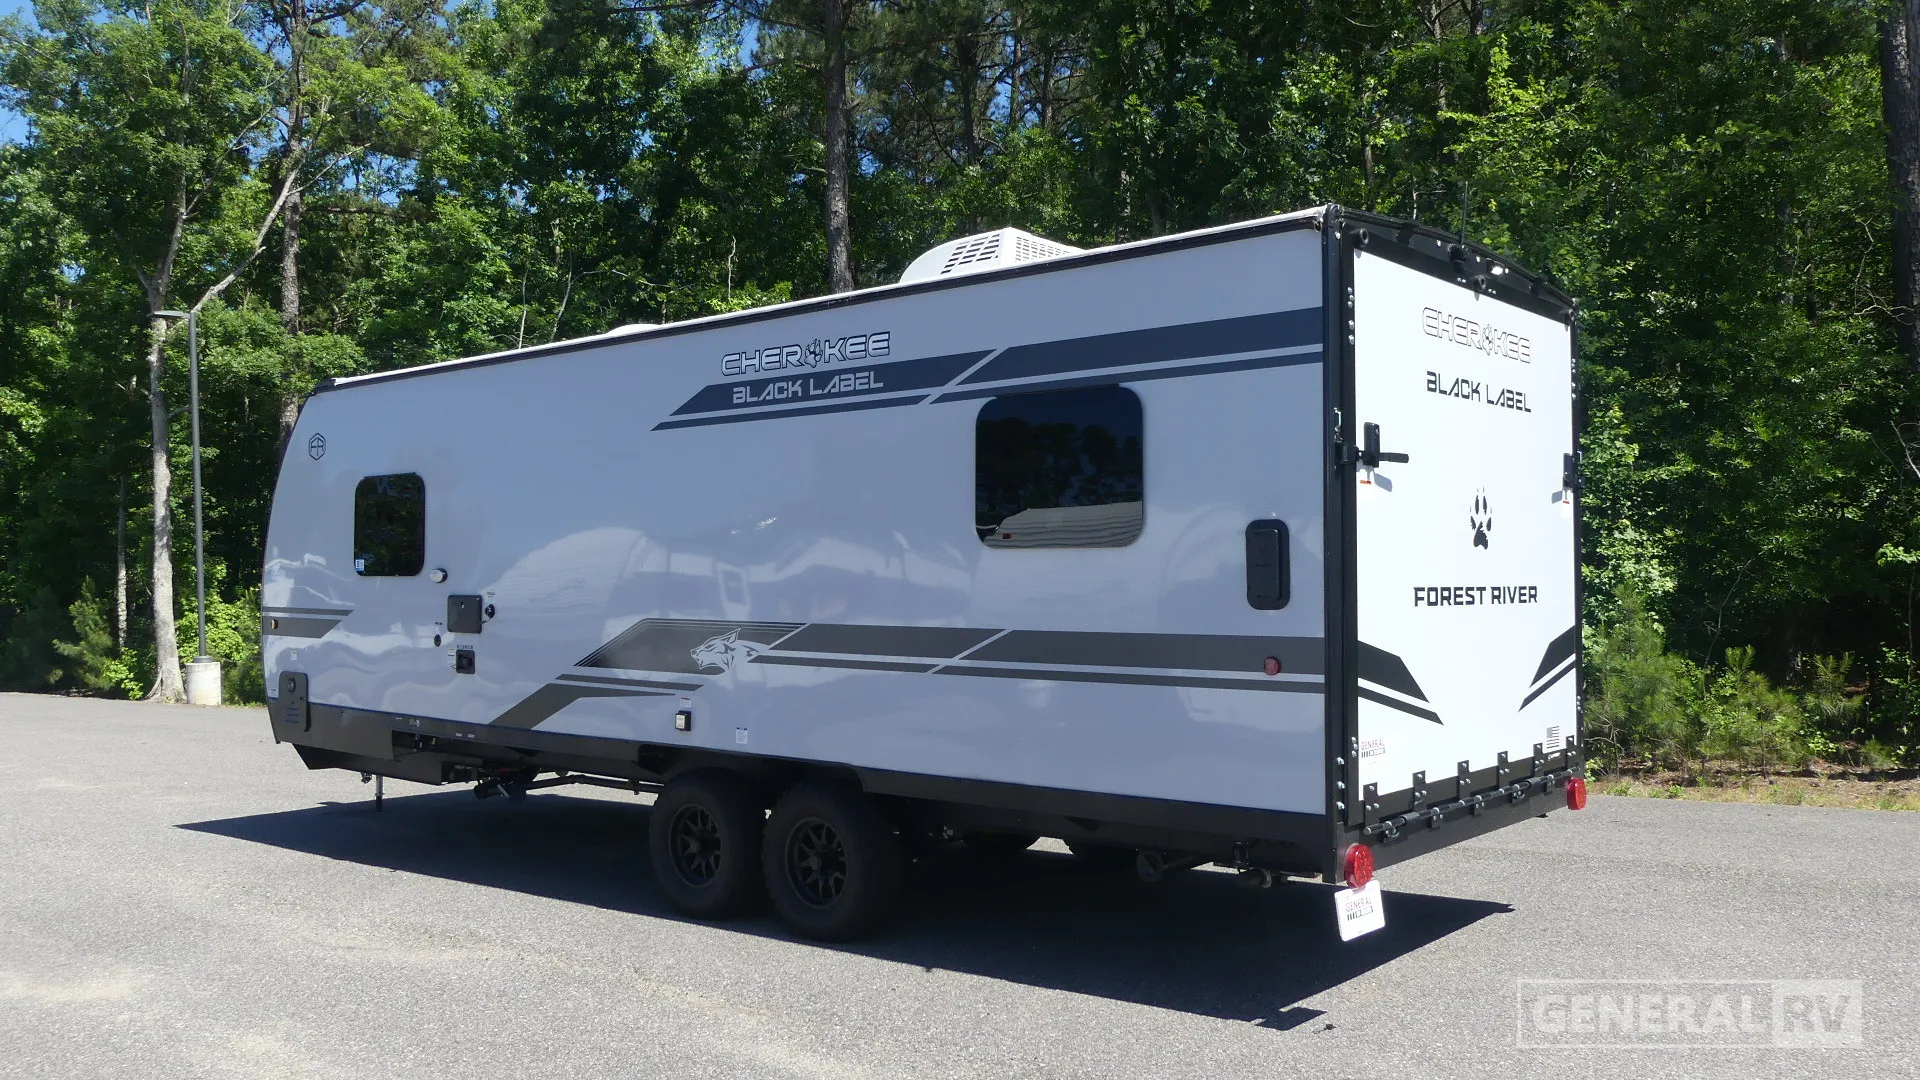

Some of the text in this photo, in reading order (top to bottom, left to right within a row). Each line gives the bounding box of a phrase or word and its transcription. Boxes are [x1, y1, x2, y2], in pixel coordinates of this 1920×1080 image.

[732, 371, 884, 404] BLACK LABEL
[1426, 370, 1532, 413] BLACK LABEL
[1413, 585, 1538, 607] FOREST RIVER
